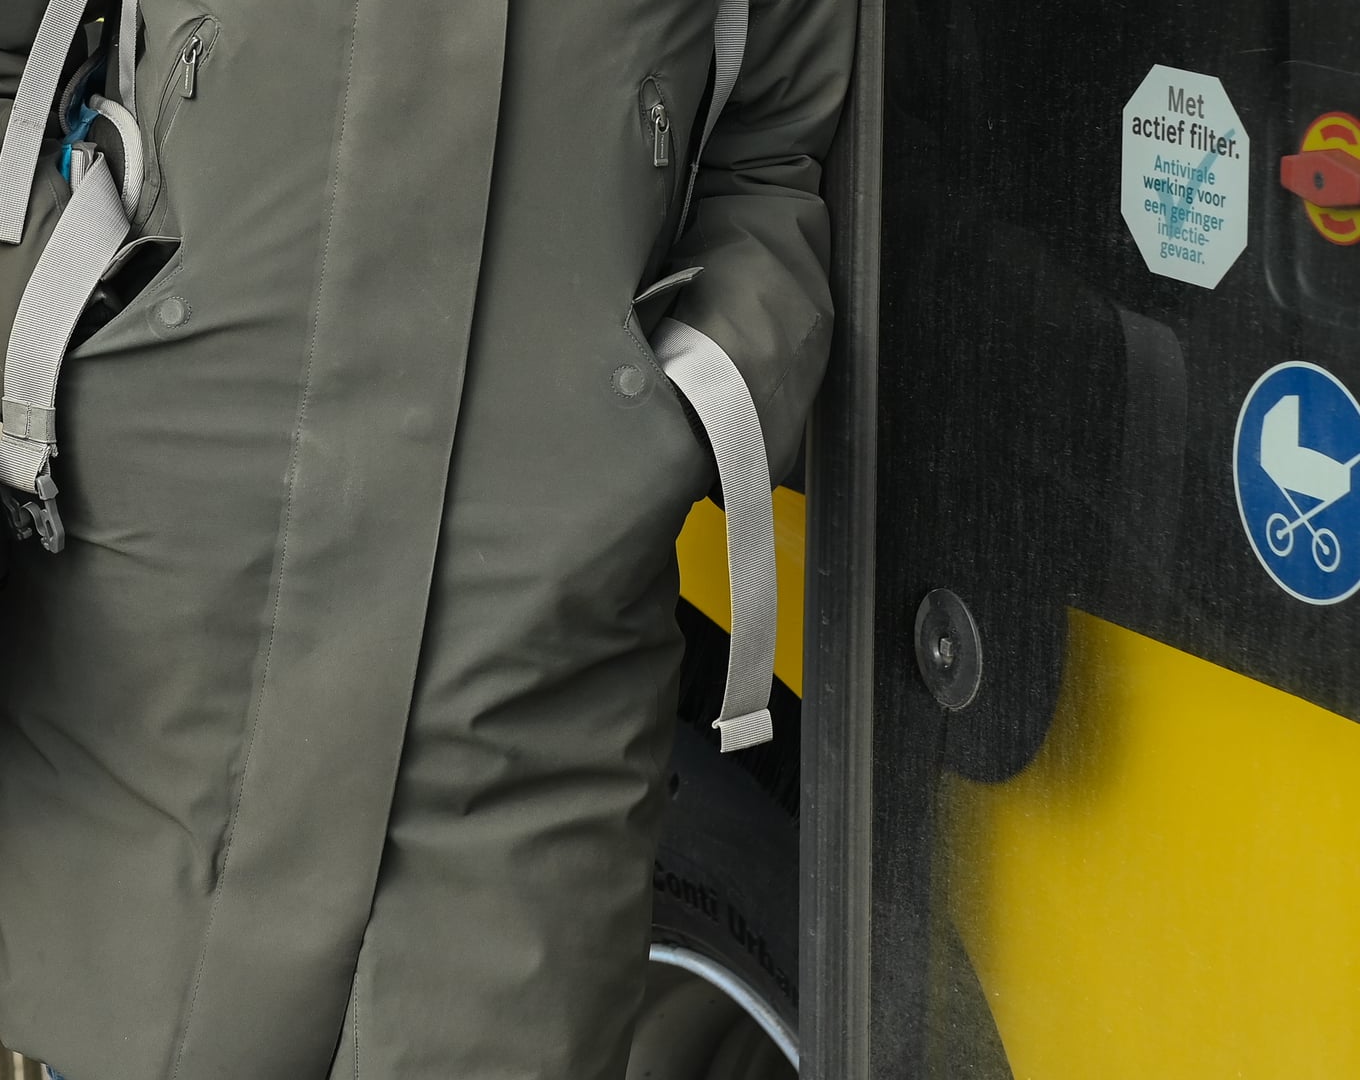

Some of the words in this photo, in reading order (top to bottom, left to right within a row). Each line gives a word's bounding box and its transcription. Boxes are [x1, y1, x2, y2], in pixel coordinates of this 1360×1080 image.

[1168, 85, 1205, 119] Met
[1132, 116, 1185, 146] actief
[1190, 123, 1240, 160] filter.
[1153, 154, 1216, 186] Antivirale
[1143, 174, 1194, 205] werking
[1197, 187, 1226, 209] voor
[1144, 198, 1167, 217] een
[1170, 204, 1224, 233] geringer
[1160, 241, 1205, 266] gevaar.
[727, 903, 799, 1008] Urba
